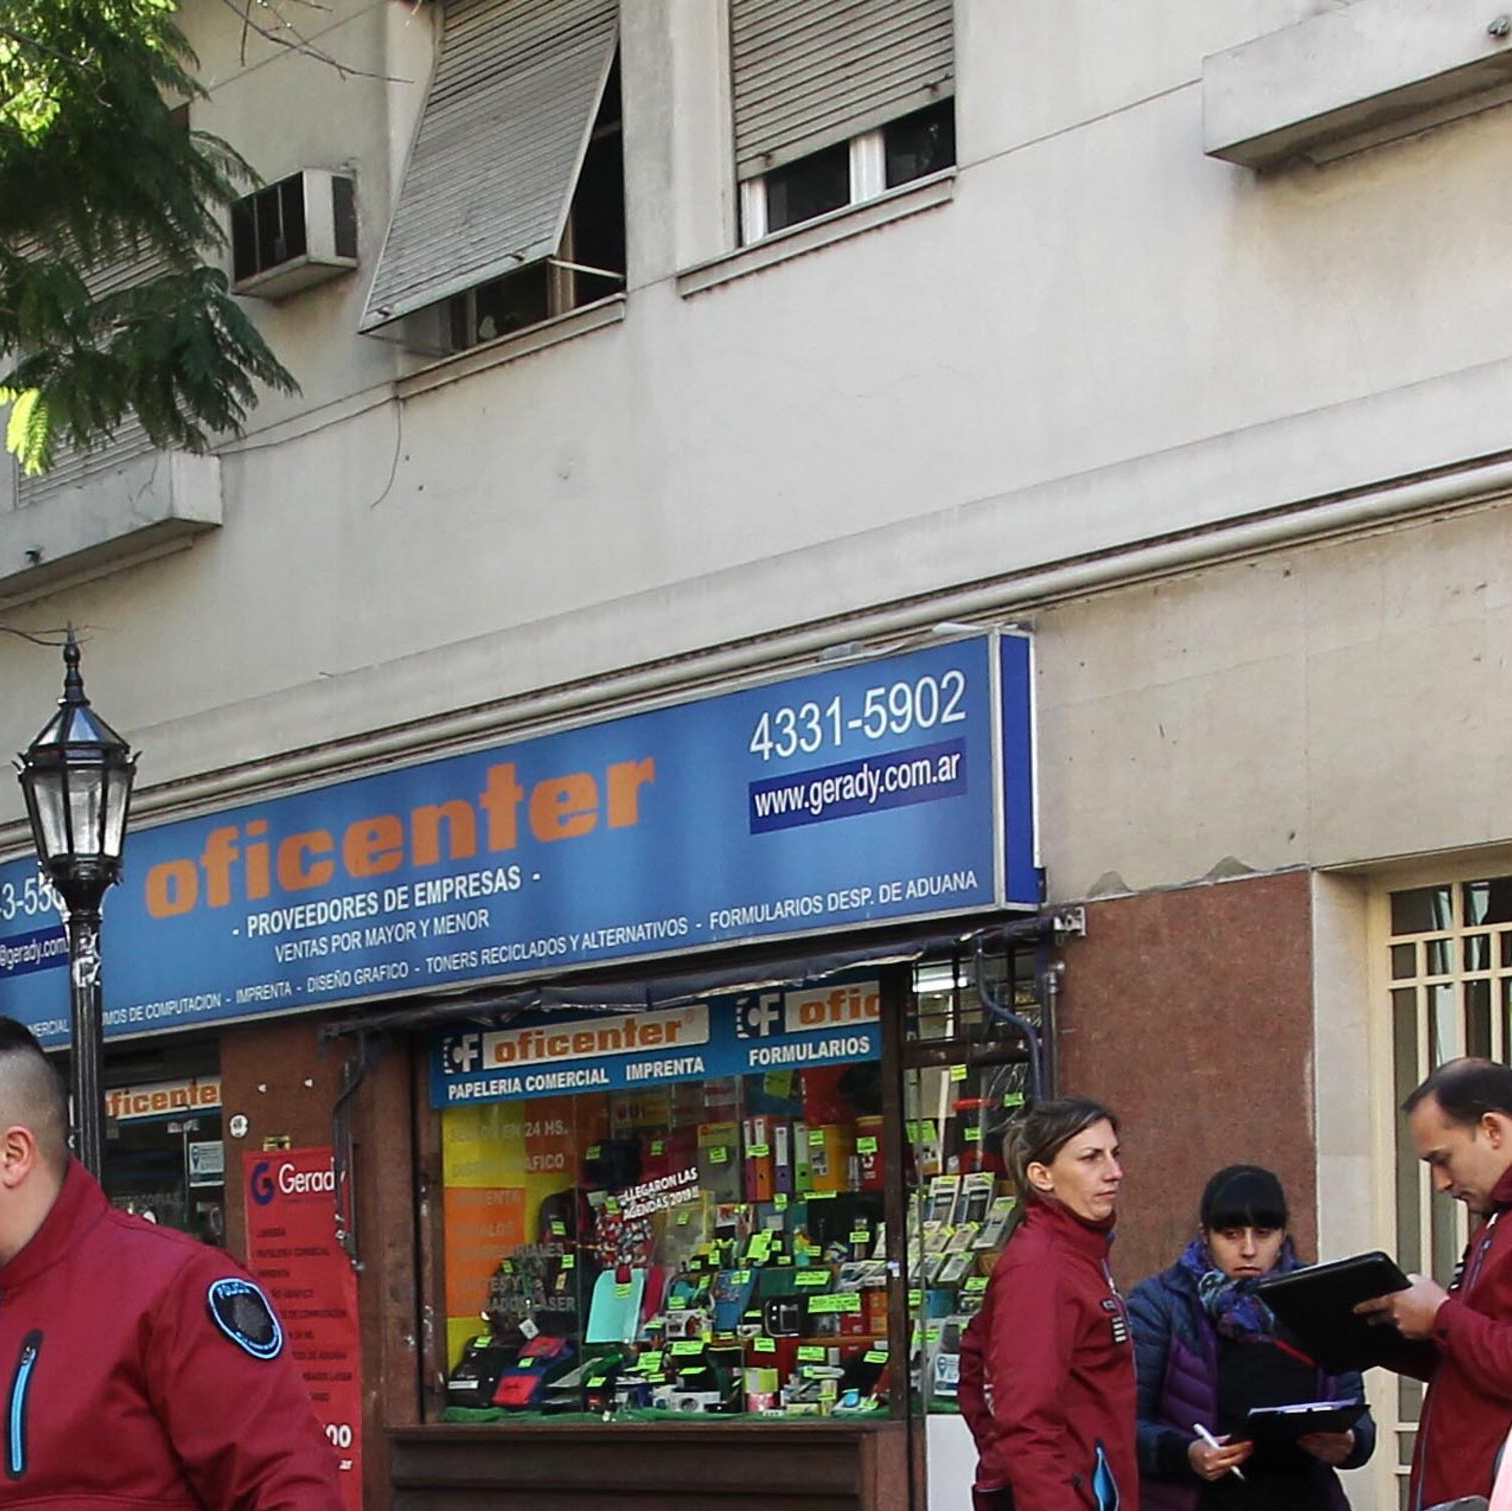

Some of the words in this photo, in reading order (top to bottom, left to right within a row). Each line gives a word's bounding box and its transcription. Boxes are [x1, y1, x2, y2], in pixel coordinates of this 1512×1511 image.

[749, 670, 967, 761] 4331-5902
[754, 750, 961, 817] www.gerady.com.ar
[146, 757, 656, 919] oficenter
[247, 892, 379, 938] PROVEEDORES
[384, 886, 409, 911] DE
[414, 865, 521, 908] EMPRESAS
[129, 1005, 144, 1022] DE
[145, 992, 221, 1020] COMPUTACION
[236, 981, 293, 1005] IMPRENTA
[307, 969, 352, 994] DISEÑO
[354, 961, 409, 986] GRAFICO
[426, 950, 479, 974] TONERS
[481, 938, 567, 966] RECICLADOS
[570, 934, 581, 951] Y
[582, 916, 689, 950] ALTERNATIVOS
[709, 895, 823, 930] FORMULARIOS
[827, 886, 874, 911] DESP.
[879, 882, 902, 903] DE
[905, 870, 978, 900] ADUANA
[275, 936, 329, 963] VENTAS
[331, 930, 362, 953] POR
[365, 921, 417, 948] MAYOR
[418, 919, 430, 938] Y
[433, 909, 490, 936] MENOR
[494, 1017, 682, 1063] oficenter
[749, 1036, 870, 1067] FORMULARIOS
[106, 1080, 218, 1117] ficente
[449, 1077, 523, 1100] PAPELERIA
[525, 1068, 609, 1091] COMERCIAL
[626, 1056, 705, 1081] IMPRENTA
[677, 1167, 698, 1184] LAS
